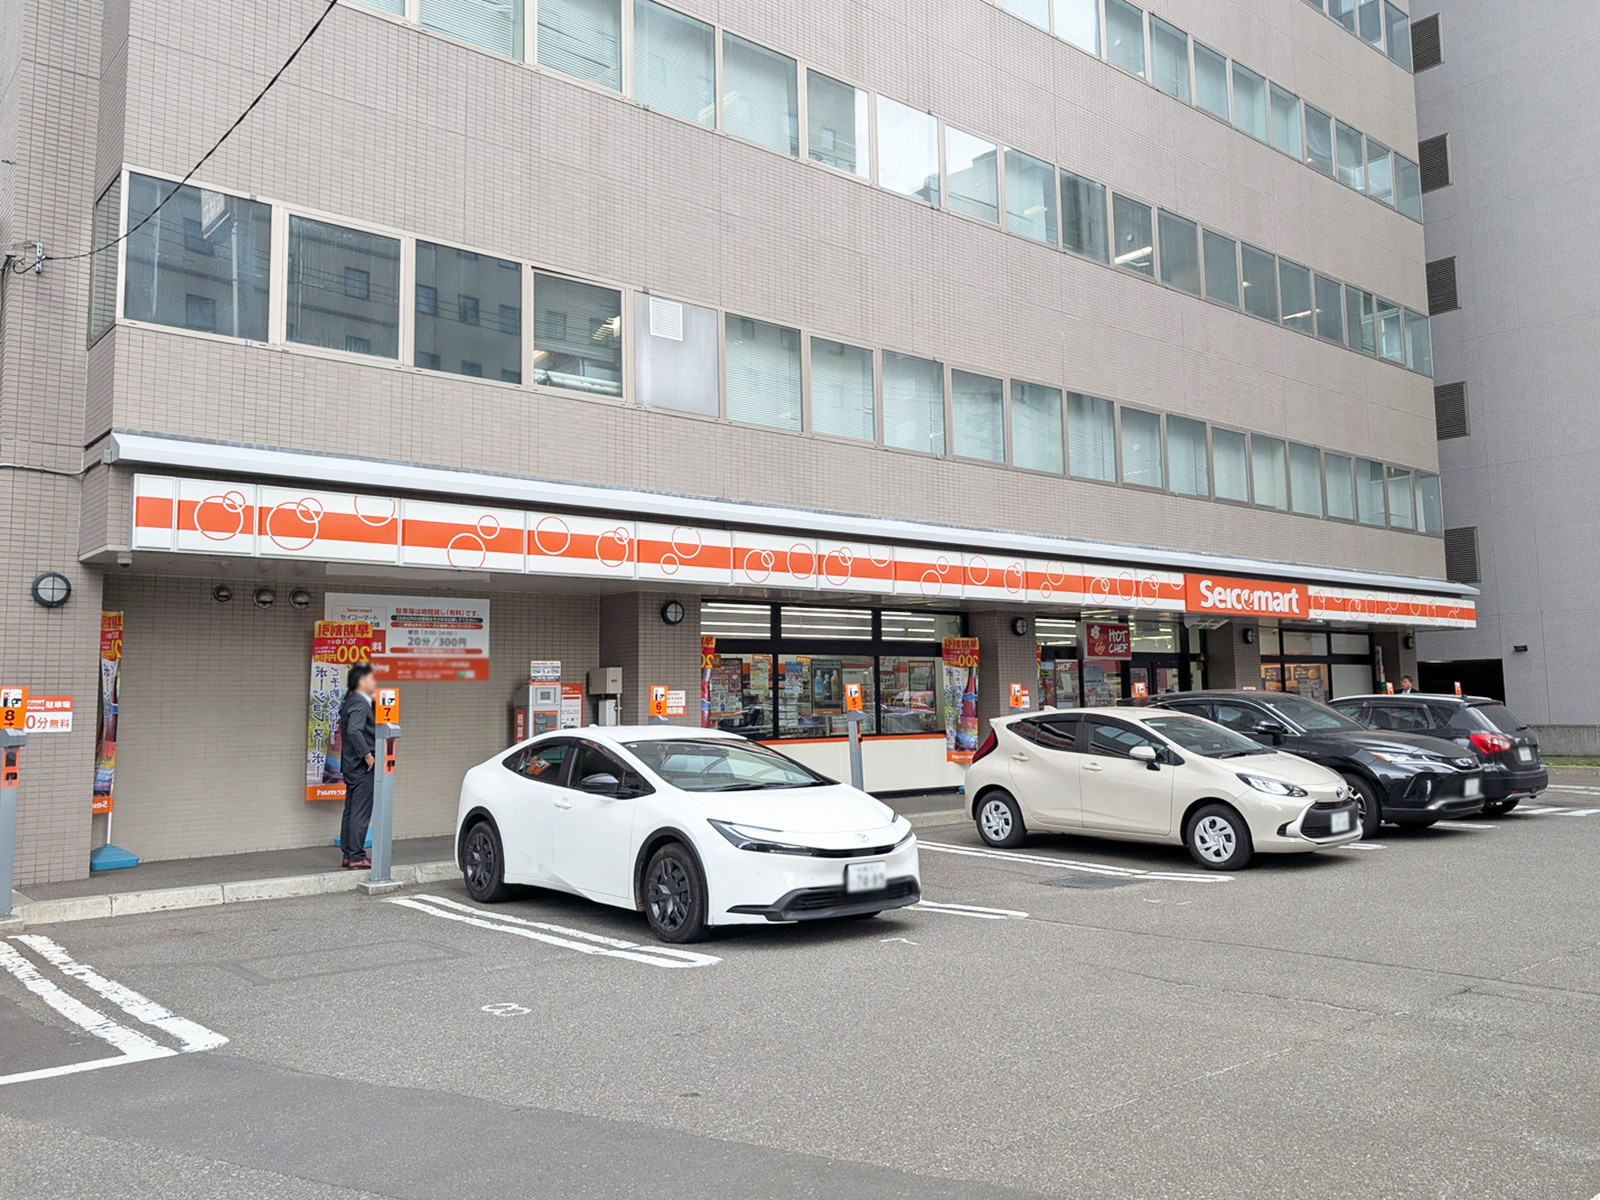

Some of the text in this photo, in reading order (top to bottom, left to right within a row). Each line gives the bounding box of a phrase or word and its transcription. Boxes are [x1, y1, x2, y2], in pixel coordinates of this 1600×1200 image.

[1200, 580, 1299, 613] Seicomart
[1108, 629, 1128, 642] HOT
[1108, 643, 1128, 653] CHEF
[383, 707, 391, 717] 7
[655, 702, 662, 711] 6
[4, 709, 15, 721] 8
